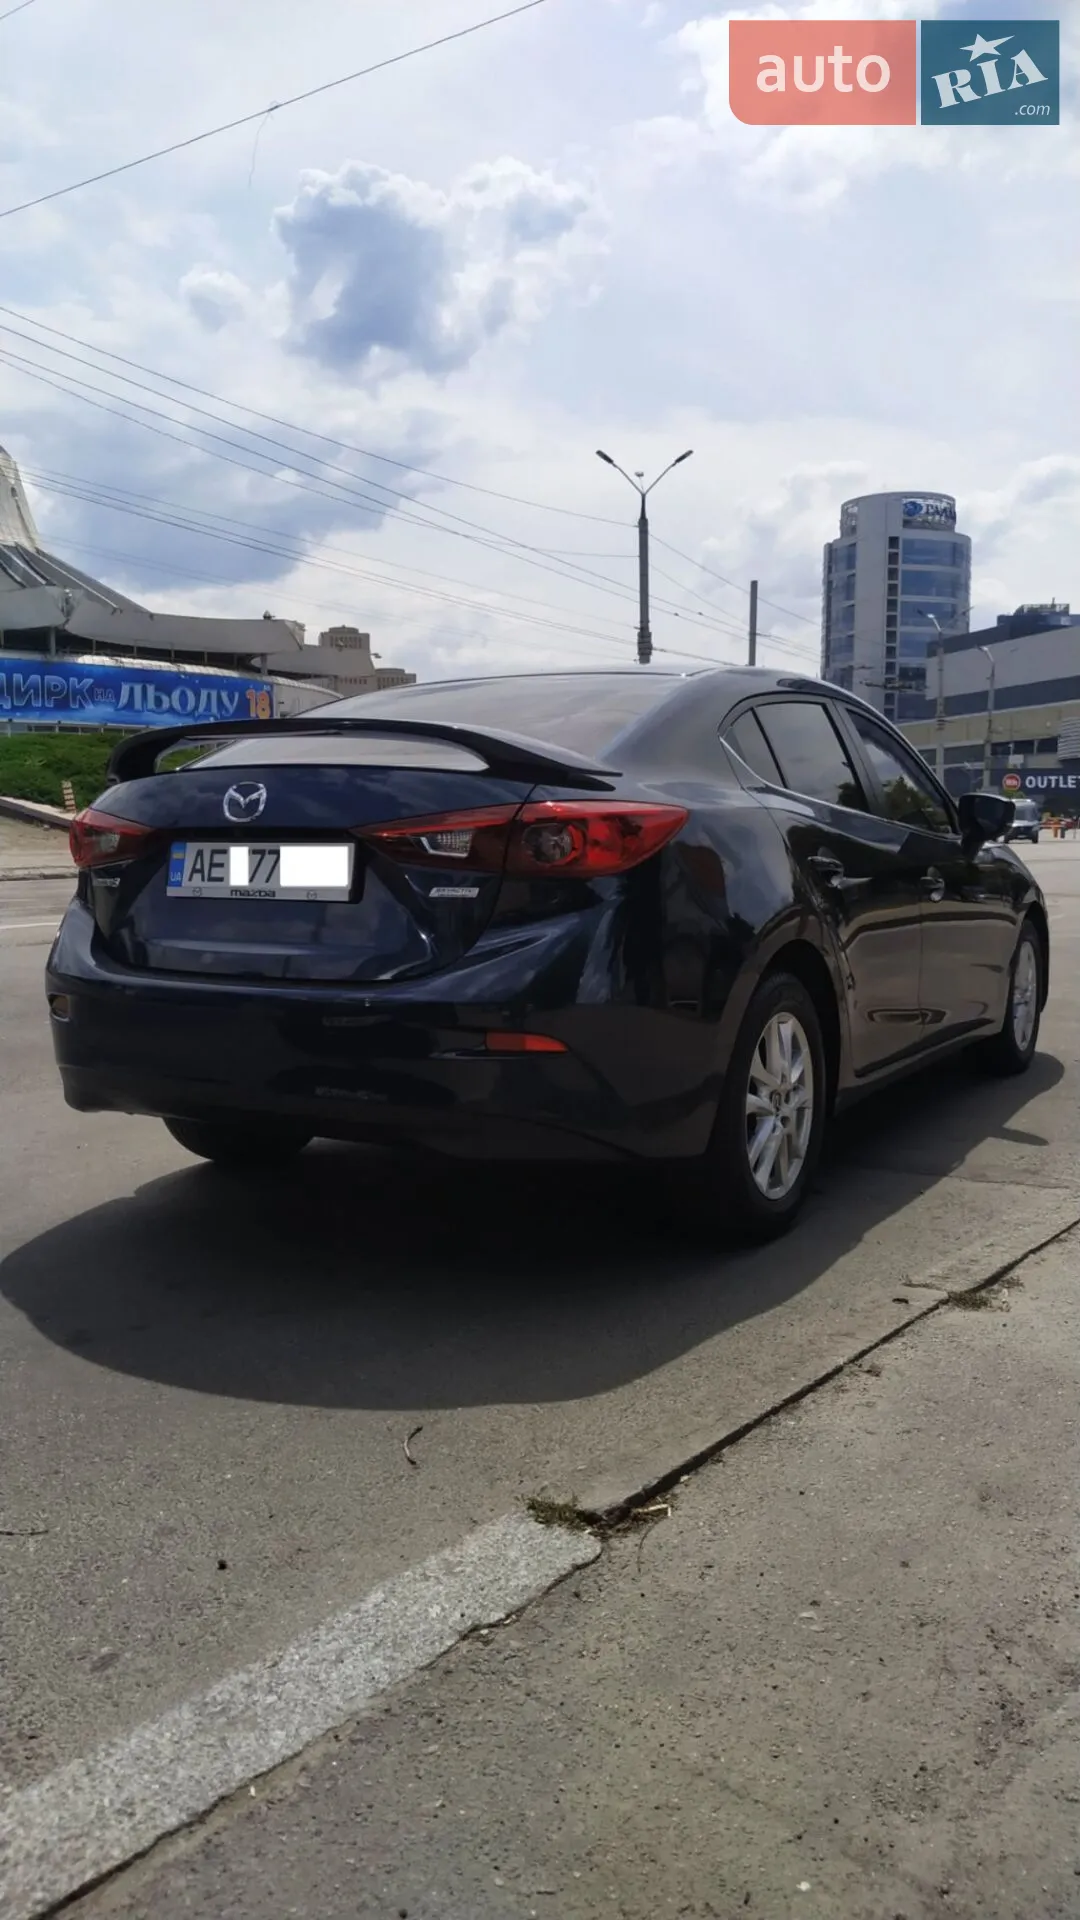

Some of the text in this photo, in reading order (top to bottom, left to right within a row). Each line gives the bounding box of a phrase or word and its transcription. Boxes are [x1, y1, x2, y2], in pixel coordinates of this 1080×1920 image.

[115, 681, 239, 720] ЛЬОДУ
[245, 688, 271, 719] 18
[1025, 775, 1080, 788] OUTLE
